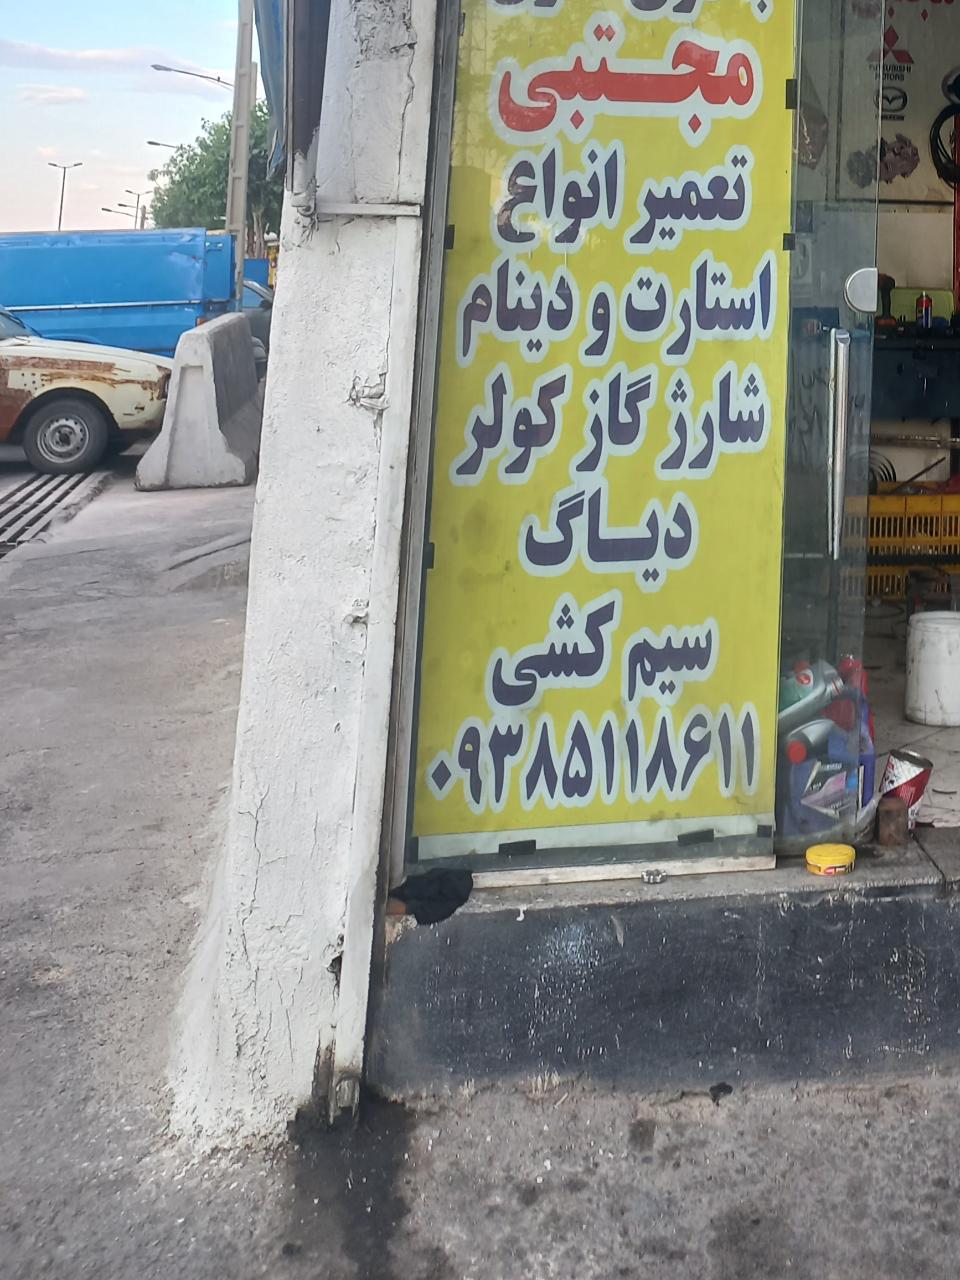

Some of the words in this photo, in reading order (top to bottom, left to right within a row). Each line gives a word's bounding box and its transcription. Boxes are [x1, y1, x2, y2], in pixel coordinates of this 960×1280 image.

[498, 24, 755, 133] مجتبی
[496, 148, 619, 244] انواع
[629, 154, 749, 244] تعمیر
[462, 258, 575, 359] دینام
[584, 285, 611, 357] و
[624, 259, 773, 357] استارت
[456, 372, 567, 475] کولر
[576, 370, 652, 473] گاز
[660, 369, 767, 471] شارژ
[525, 487, 693, 583] دیاگ
[492, 600, 616, 706] کشی
[627, 627, 713, 702] سیم
[431, 710, 756, 805] ۰۹۳۸۵۱۱۸۶۱۱
